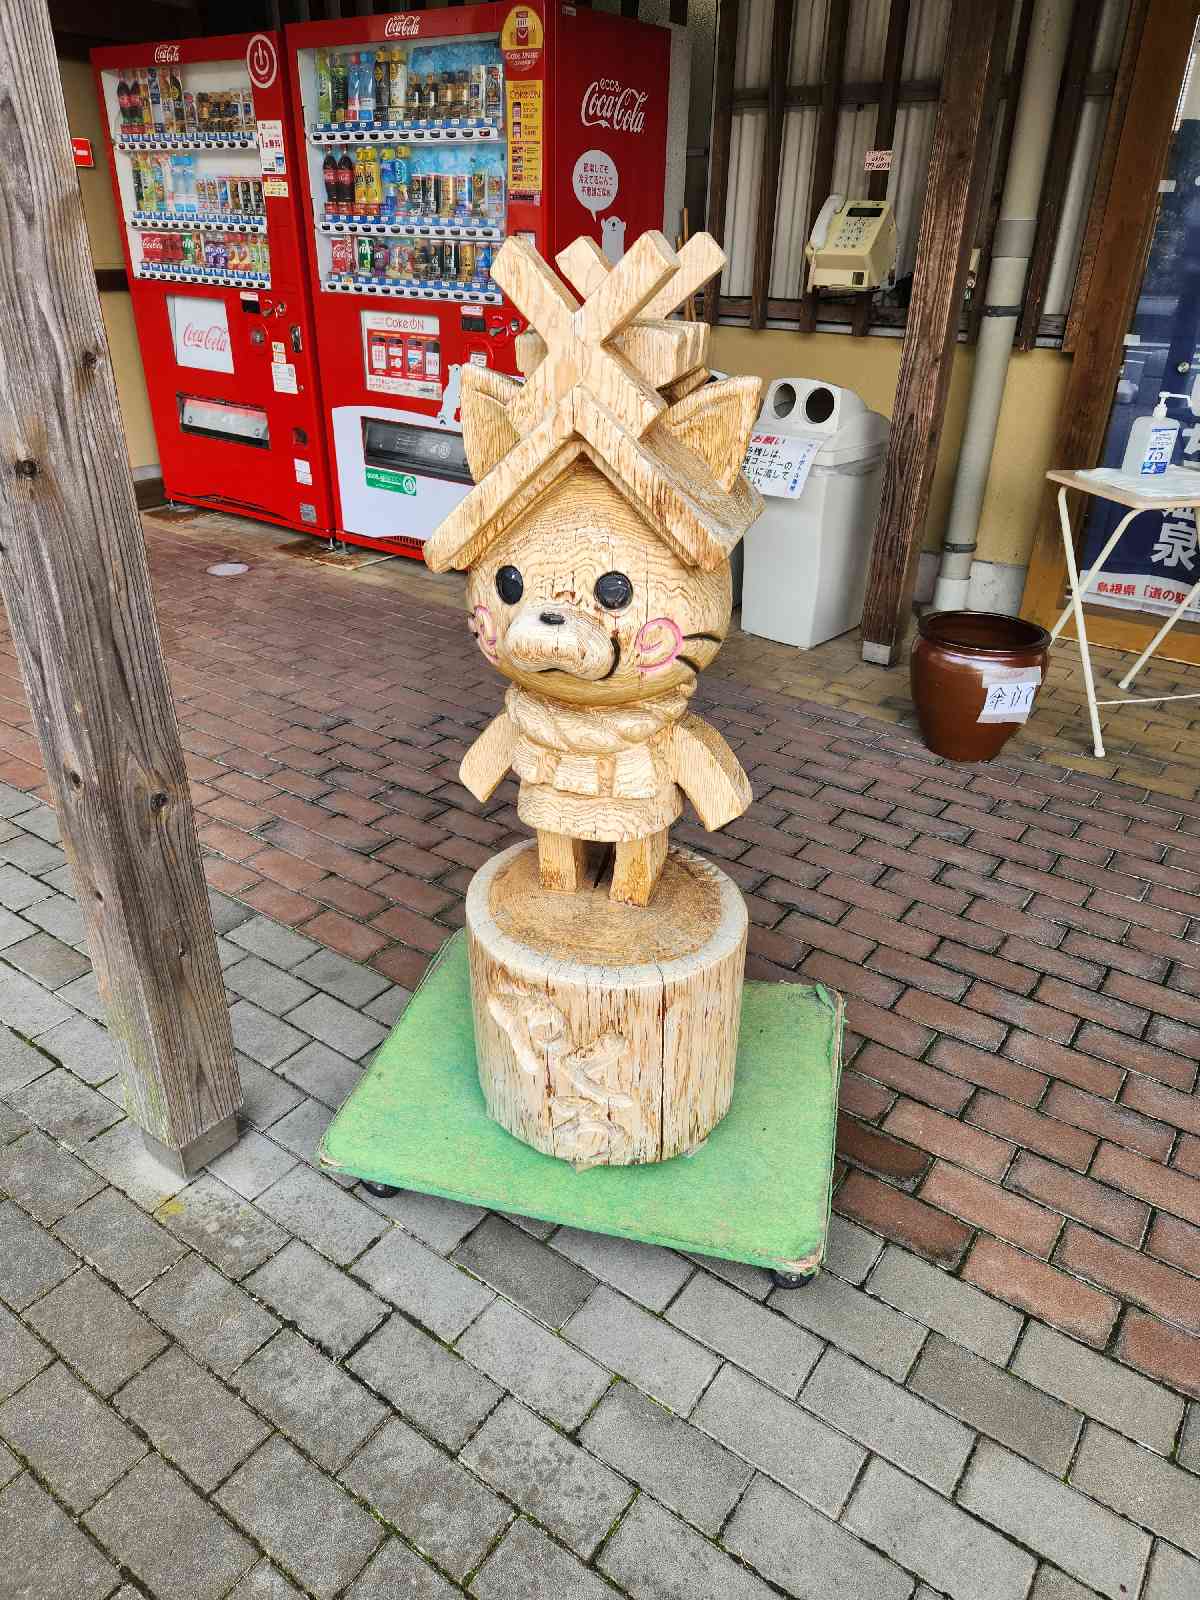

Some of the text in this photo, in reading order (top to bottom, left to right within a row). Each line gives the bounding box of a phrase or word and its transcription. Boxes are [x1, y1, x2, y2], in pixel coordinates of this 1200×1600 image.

[385, 15, 421, 37] Coca-Cola
[581, 81, 649, 133] Coca-Cola
[183, 322, 227, 352] Coca-Cola
[1151, 508, 1198, 571] 泉
